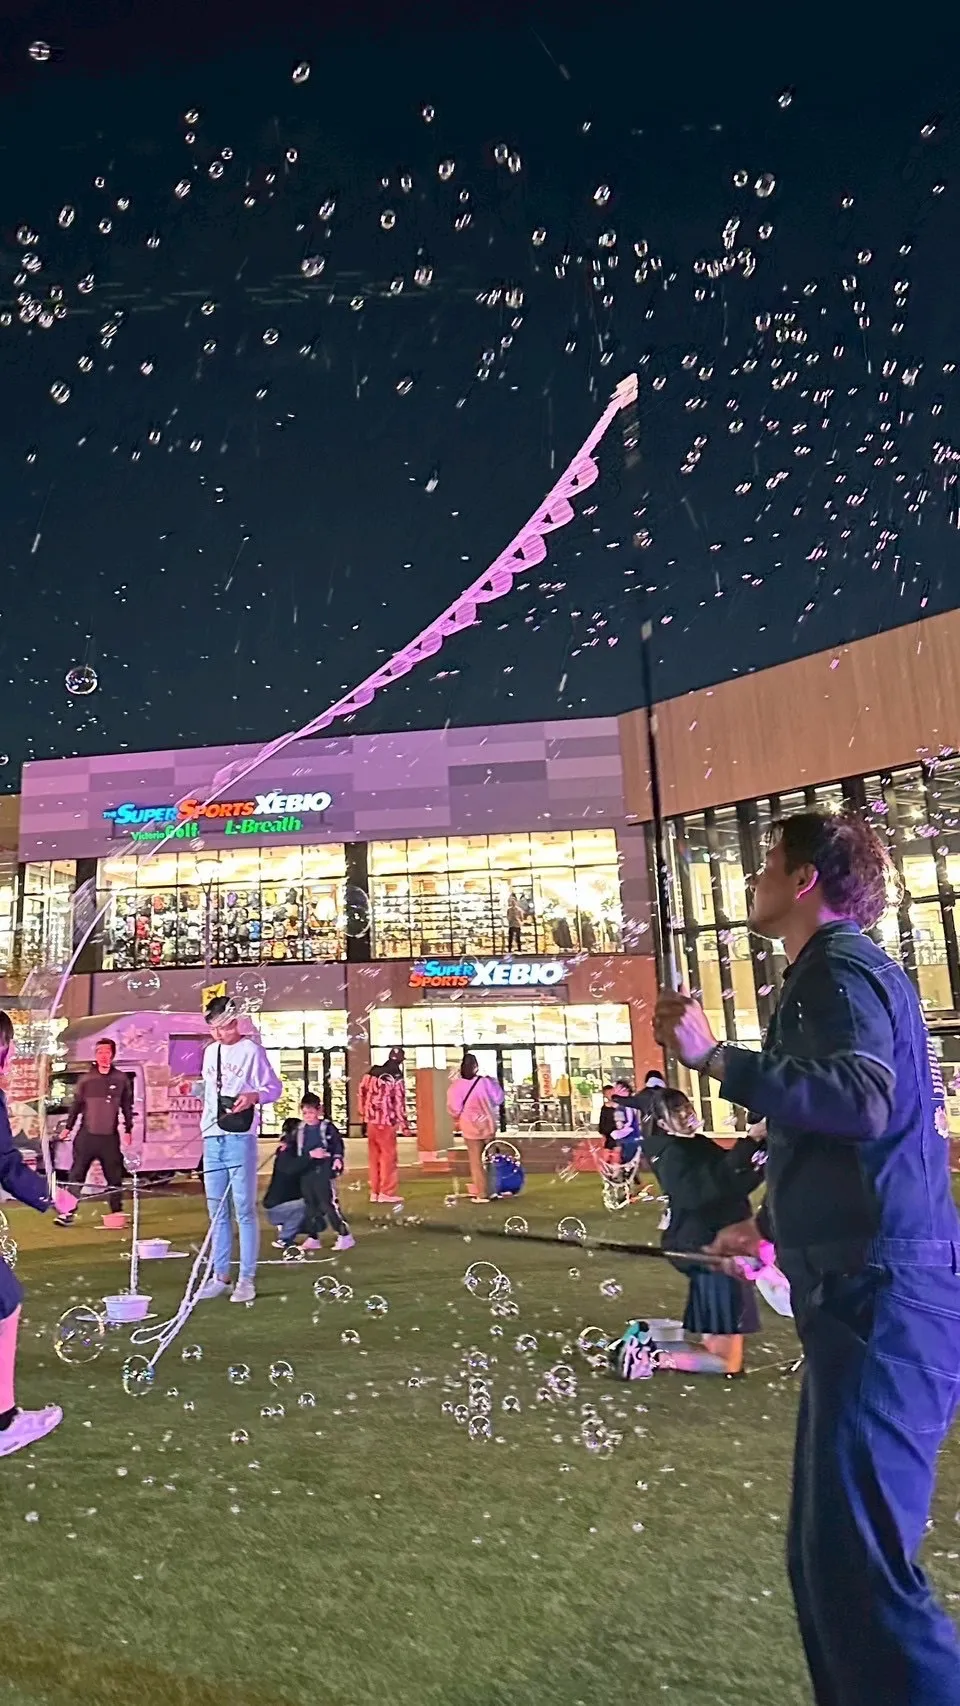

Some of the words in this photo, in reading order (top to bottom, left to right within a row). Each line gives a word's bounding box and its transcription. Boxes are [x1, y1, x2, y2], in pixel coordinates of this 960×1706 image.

[253, 791, 332, 815] XEBIO
[165, 823, 199, 839] Golf
[424, 960, 475, 977] SUPER
[470, 961, 565, 986] XEBIO
[408, 974, 469, 988] SPORTS
